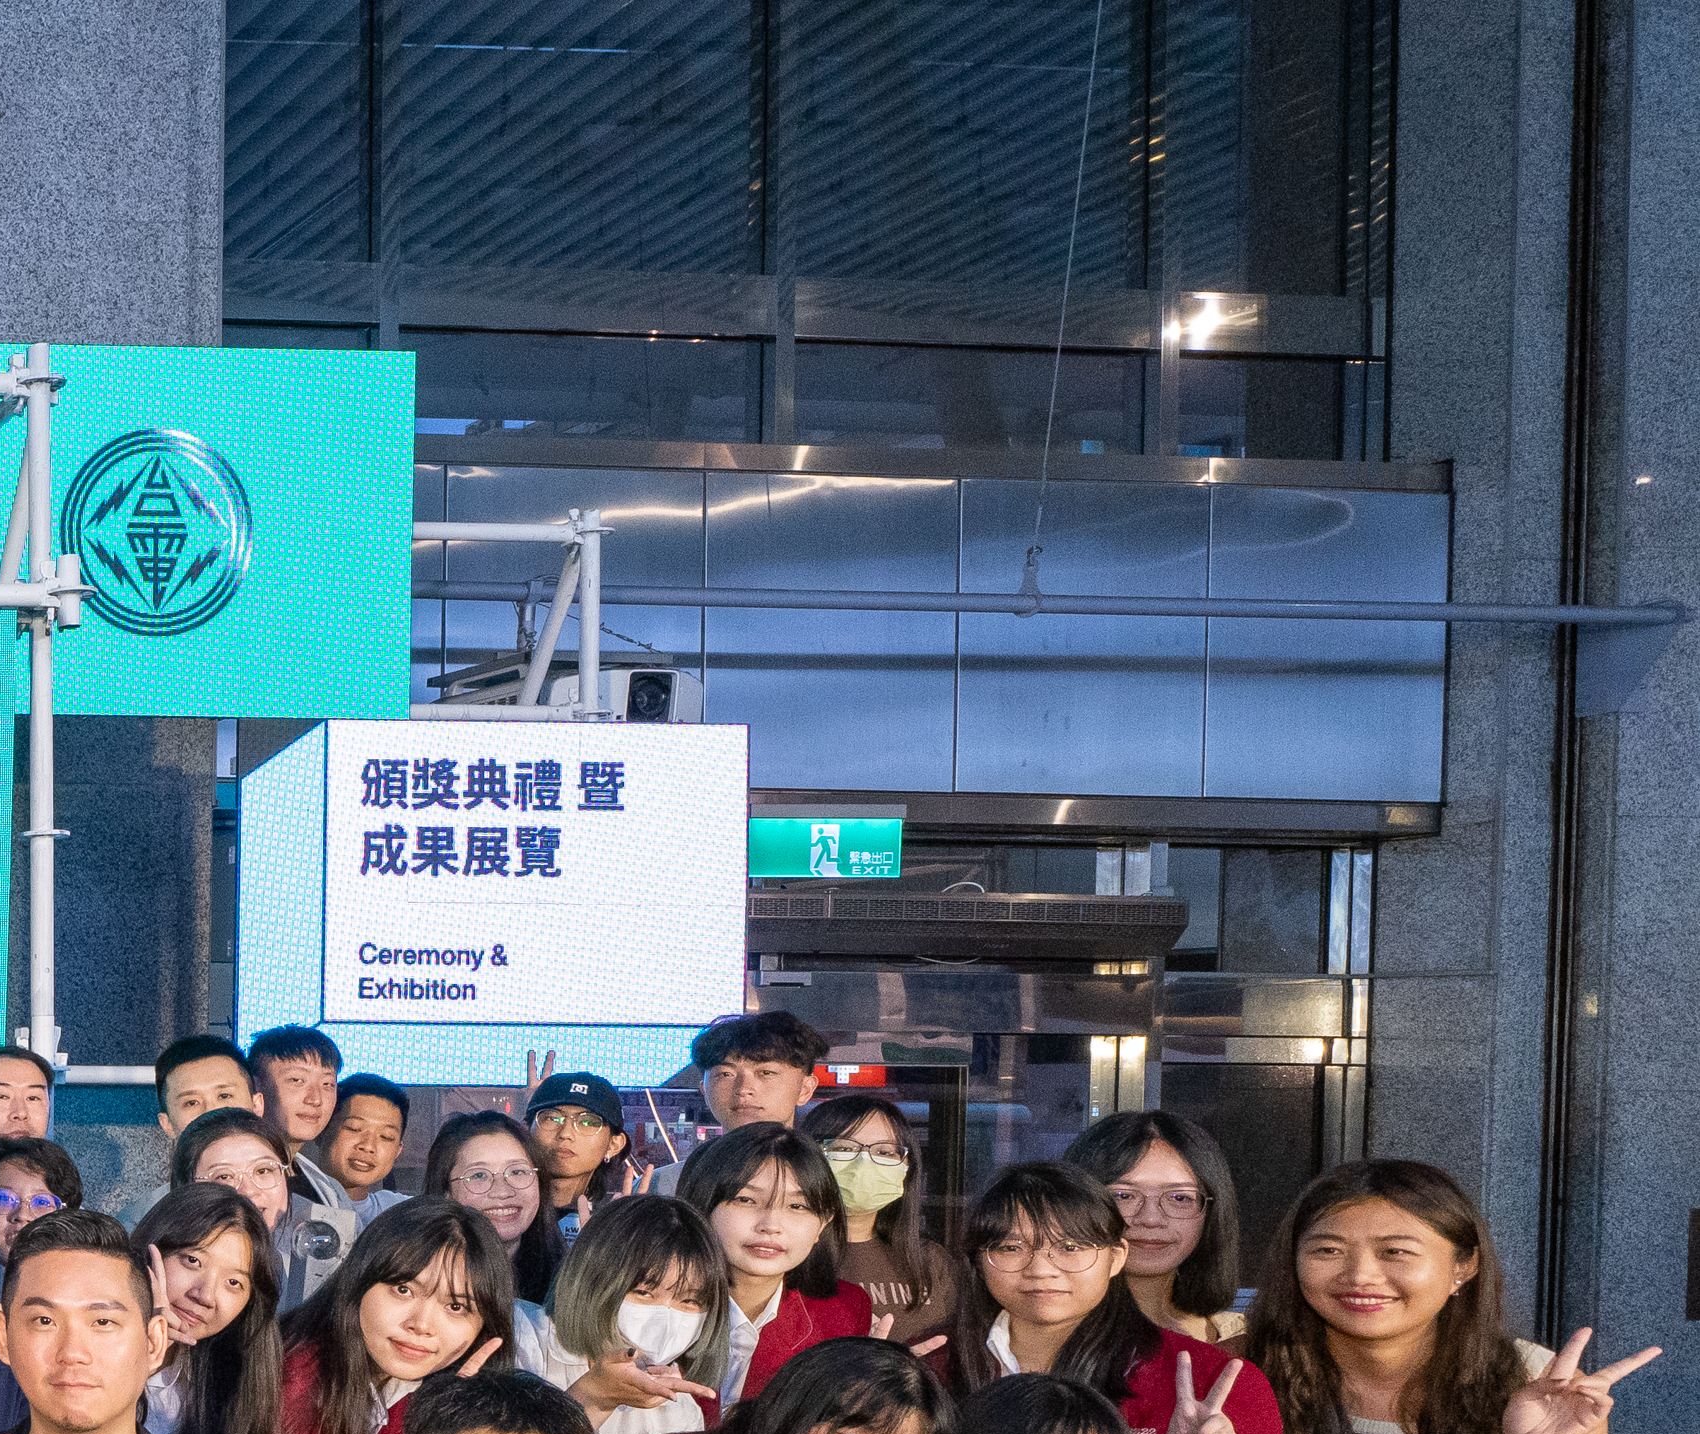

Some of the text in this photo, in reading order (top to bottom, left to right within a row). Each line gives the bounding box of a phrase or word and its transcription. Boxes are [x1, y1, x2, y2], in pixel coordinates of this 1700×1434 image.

[361, 758, 625, 811] 頒獎典禮 暨
[360, 824, 562, 877] 成果展覽
[849, 851, 893, 864] 緊急出口
[852, 866, 891, 874] EXIT
[359, 942, 508, 971] Ceremony &
[358, 977, 476, 1000] Exhibition
